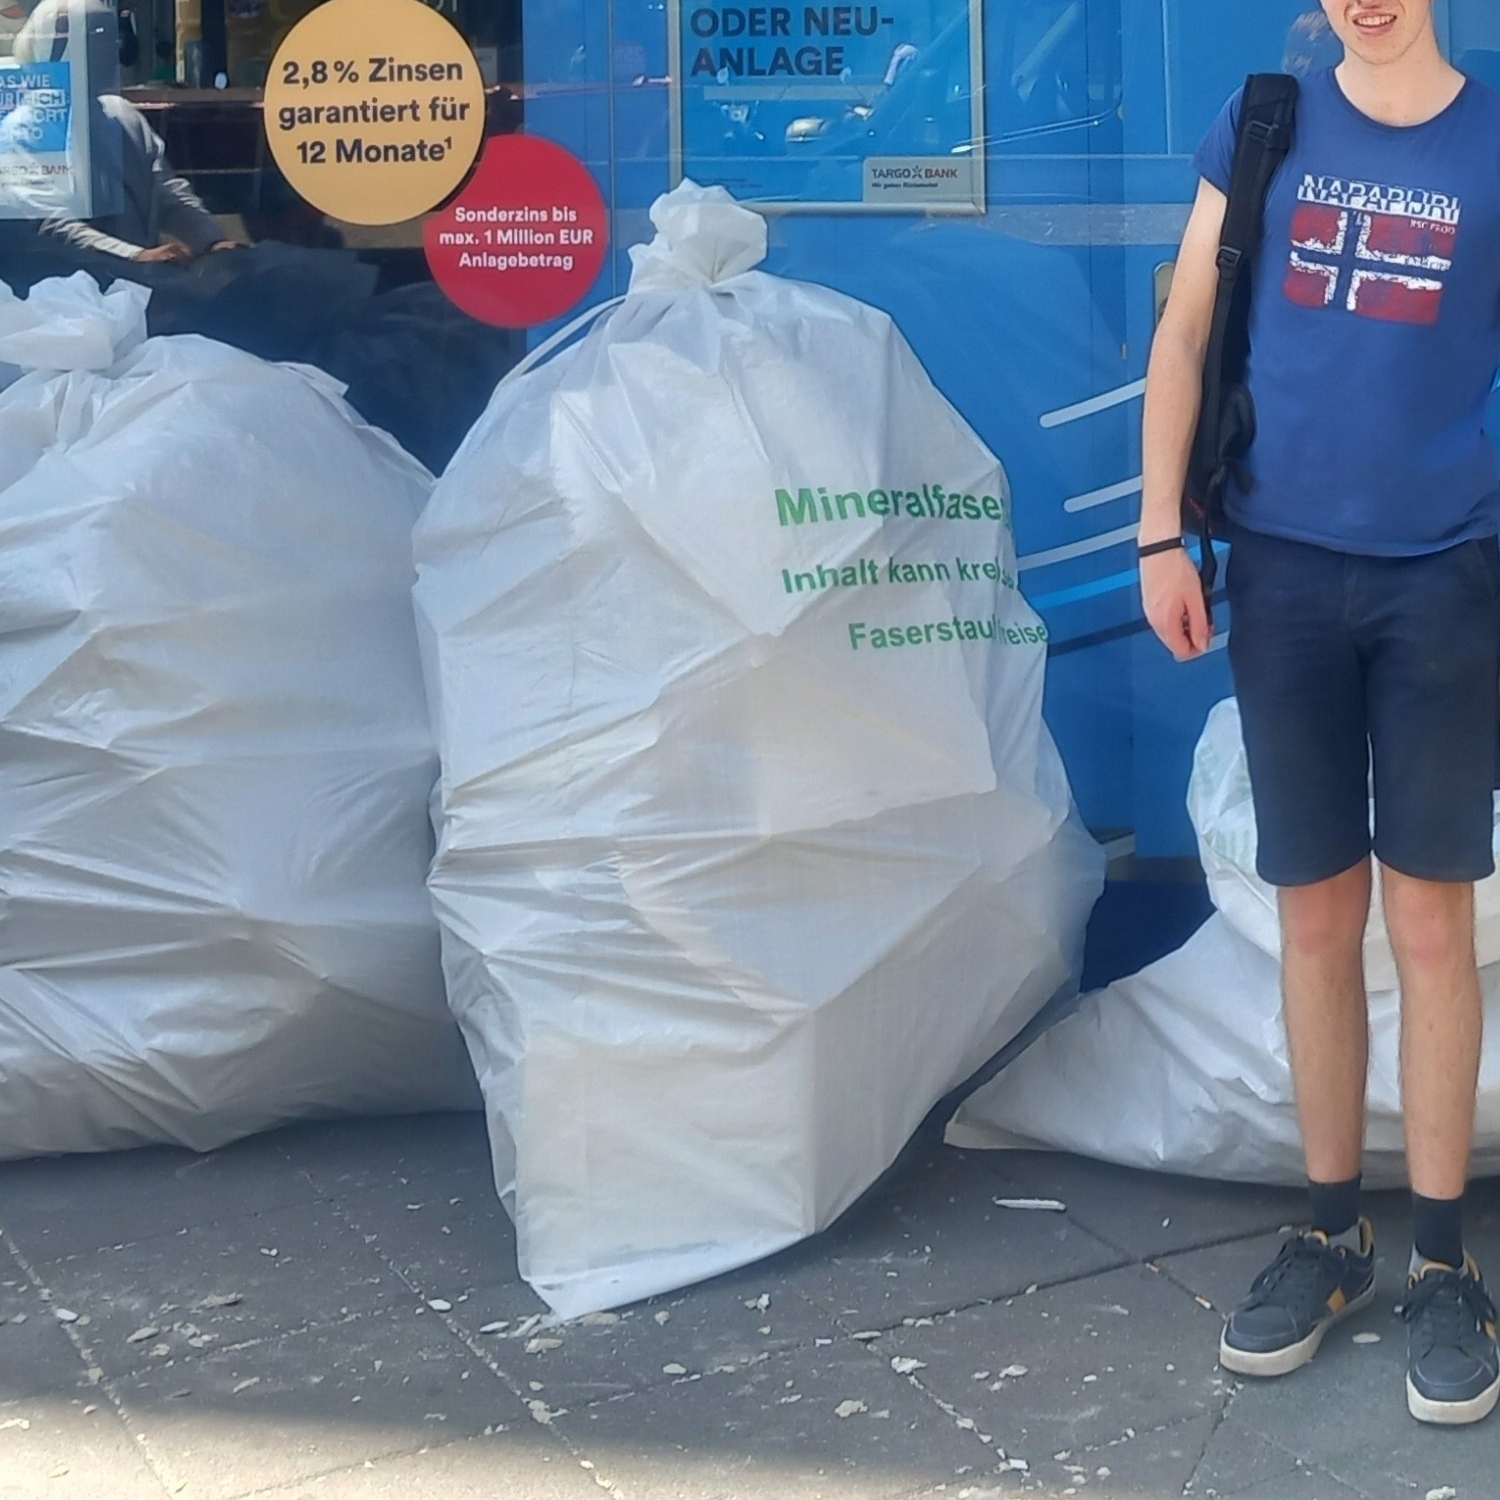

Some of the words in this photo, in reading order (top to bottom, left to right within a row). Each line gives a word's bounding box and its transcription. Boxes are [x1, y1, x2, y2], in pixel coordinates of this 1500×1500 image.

[690, 7, 792, 38] ODER
[803, 6, 894, 37] NEU-
[368, 57, 464, 83] Zinsen
[690, 46, 845, 77] ANLAGE
[278, 97, 421, 131] garantiert
[428, 96, 470, 122] für
[297, 141, 326, 164] 12
[455, 206, 548, 222] Sonderzins
[552, 206, 577, 222] bis
[439, 232, 480, 245] max.
[484, 230, 492, 244] 1
[497, 228, 555, 245] Million
[559, 229, 593, 244] EUR
[459, 252, 573, 271] Anlagebetrag
[774, 483, 1004, 527] Mineralfase
[782, 558, 878, 593] Inhalt
[889, 556, 950, 584] kann
